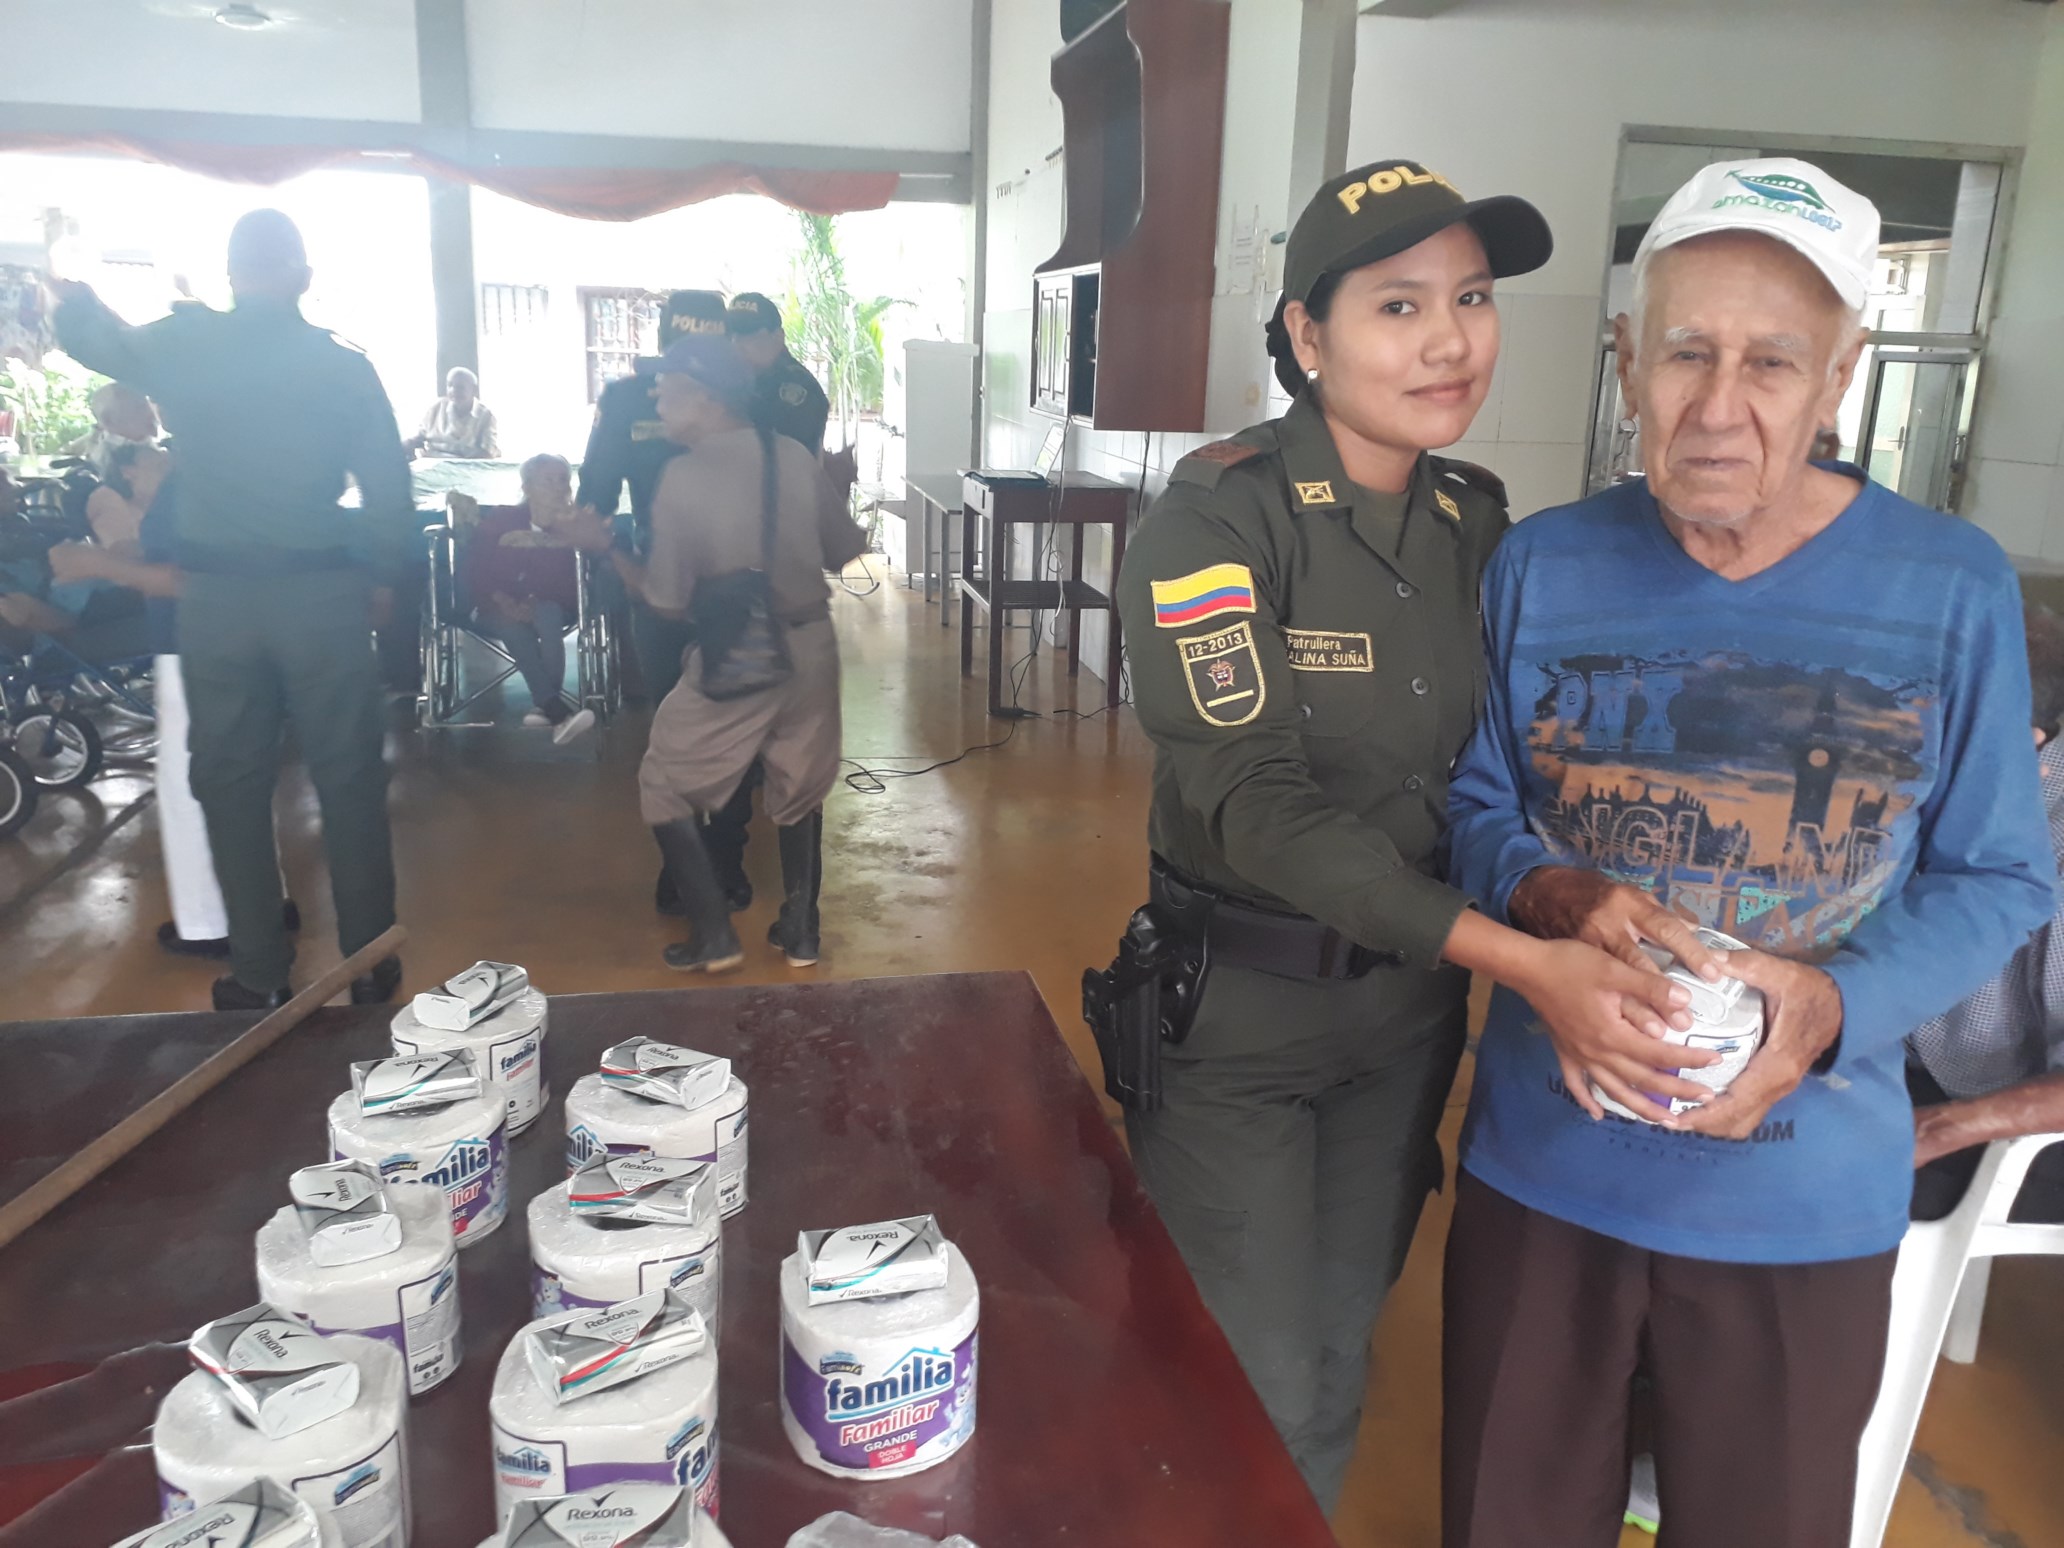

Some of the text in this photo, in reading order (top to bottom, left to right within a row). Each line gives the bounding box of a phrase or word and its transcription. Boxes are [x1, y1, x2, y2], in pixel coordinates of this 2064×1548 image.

[1188, 632, 1243, 657] 12-2013
[1287, 635, 1342, 650] Patrullera
[1286, 649, 1366, 666] ALINA SUÑA
[619, 1162, 664, 1173] Rexona
[849, 1231, 900, 1242] Rexona
[584, 1308, 640, 1330] Rexona
[253, 1328, 289, 1359] Rexona
[828, 1356, 953, 1411] familia
[841, 1402, 938, 1446] Familiar
[864, 1430, 918, 1452] GRANDE
[877, 1445, 907, 1458] DOBLE
[567, 1506, 635, 1522] Rexona
